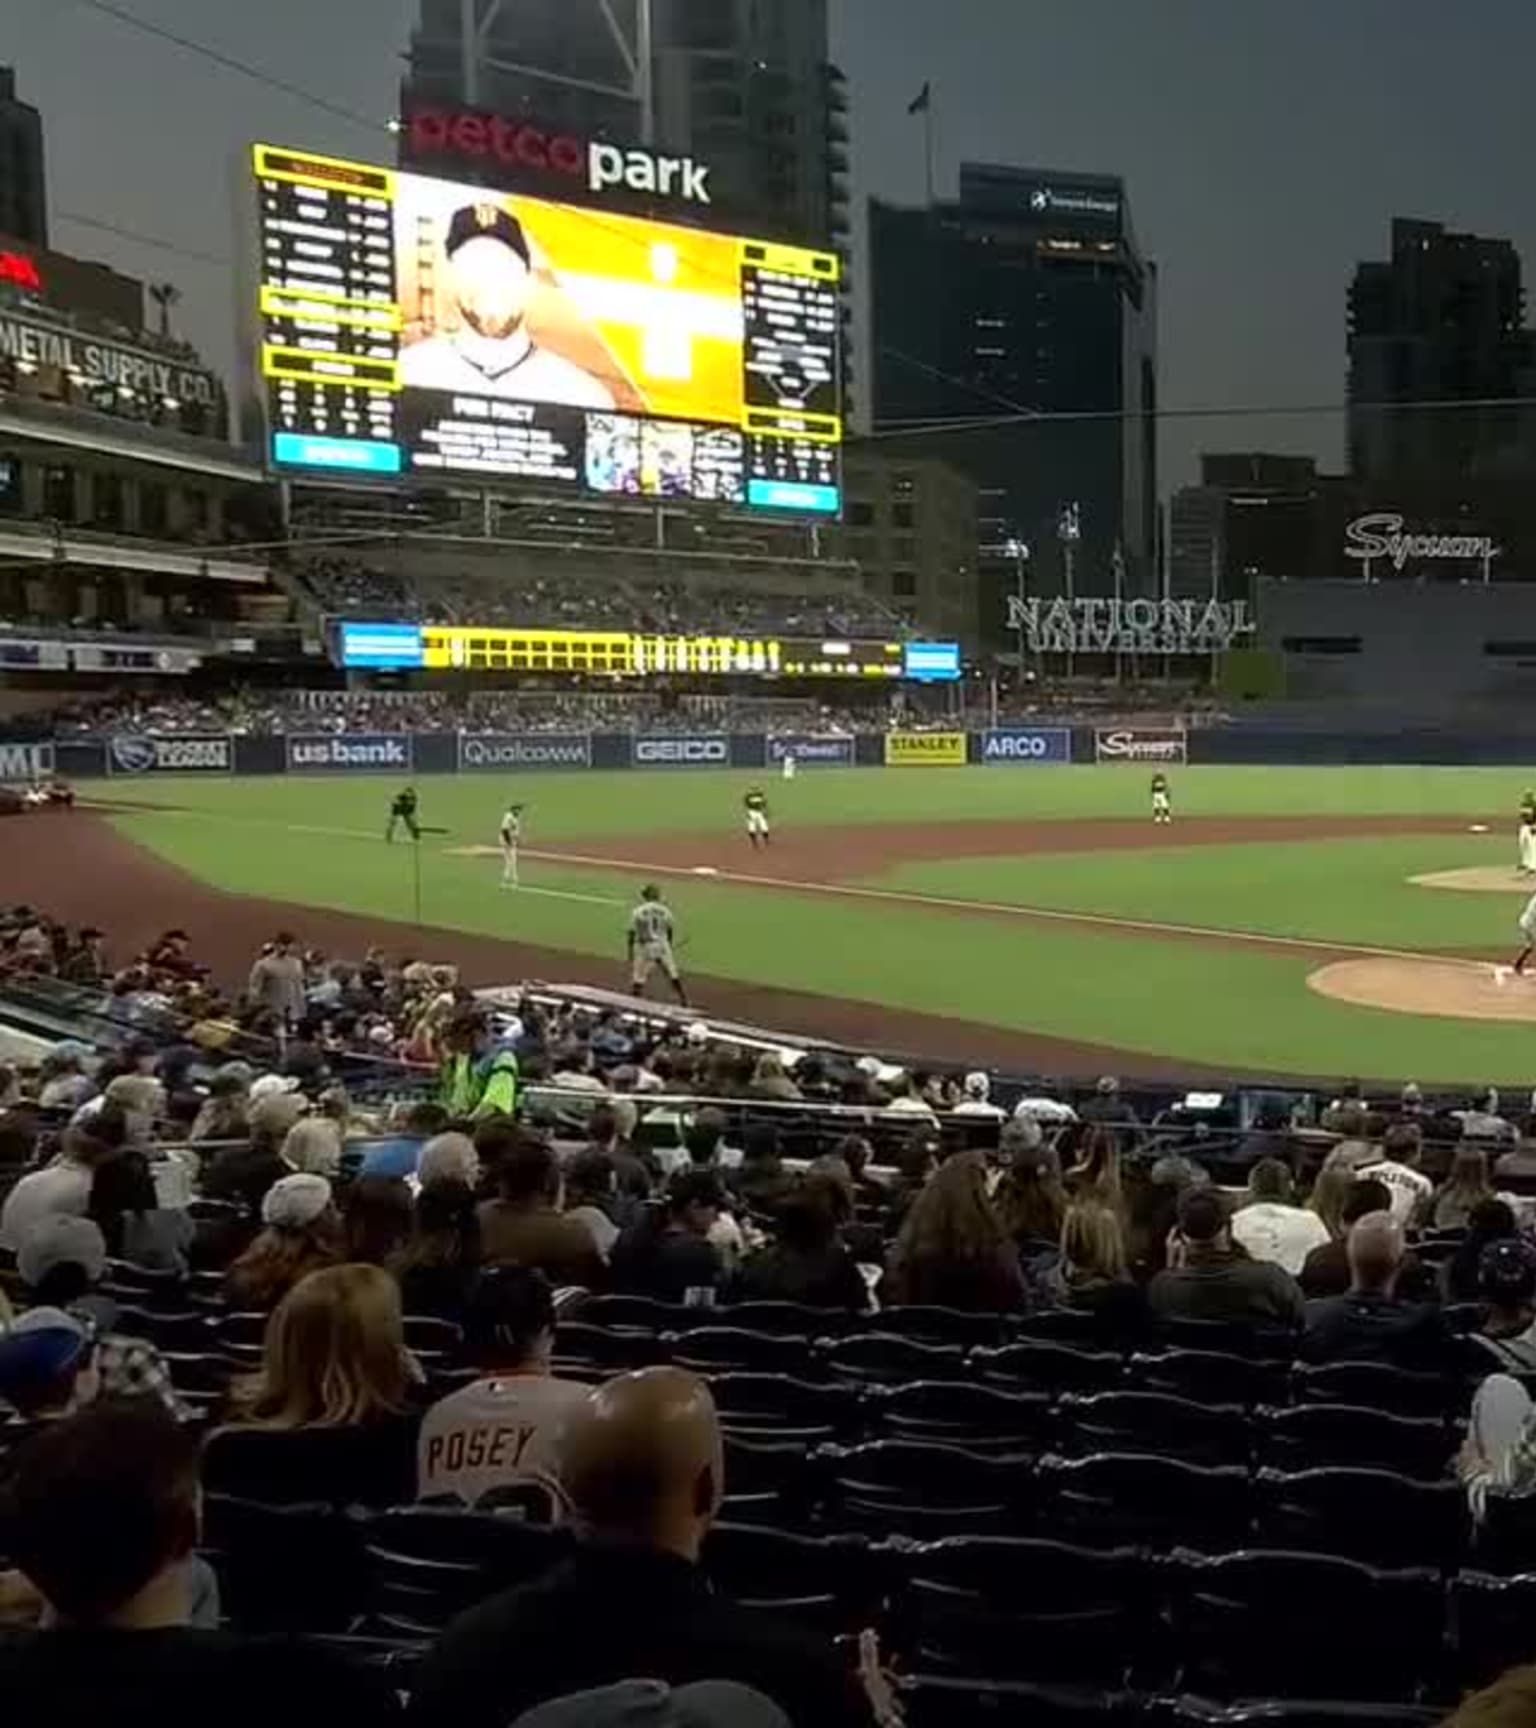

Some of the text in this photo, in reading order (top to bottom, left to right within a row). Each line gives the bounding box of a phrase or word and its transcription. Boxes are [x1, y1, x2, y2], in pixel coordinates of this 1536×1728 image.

[411, 113, 711, 203] petco park
[0, 322, 73, 366] METAL
[85, 345, 172, 394] SUPPLY
[1344, 512, 1501, 570] Sycuan
[1006, 595, 1256, 632] NATIONAL
[1028, 624, 1235, 653] UNIVERSITY
[463, 740, 587, 764] Qualcomm
[636, 741, 727, 760] GEICO
[890, 736, 960, 750] STANLEY
[984, 736, 1046, 756] ARCO
[427, 1424, 536, 1480] POSEY
